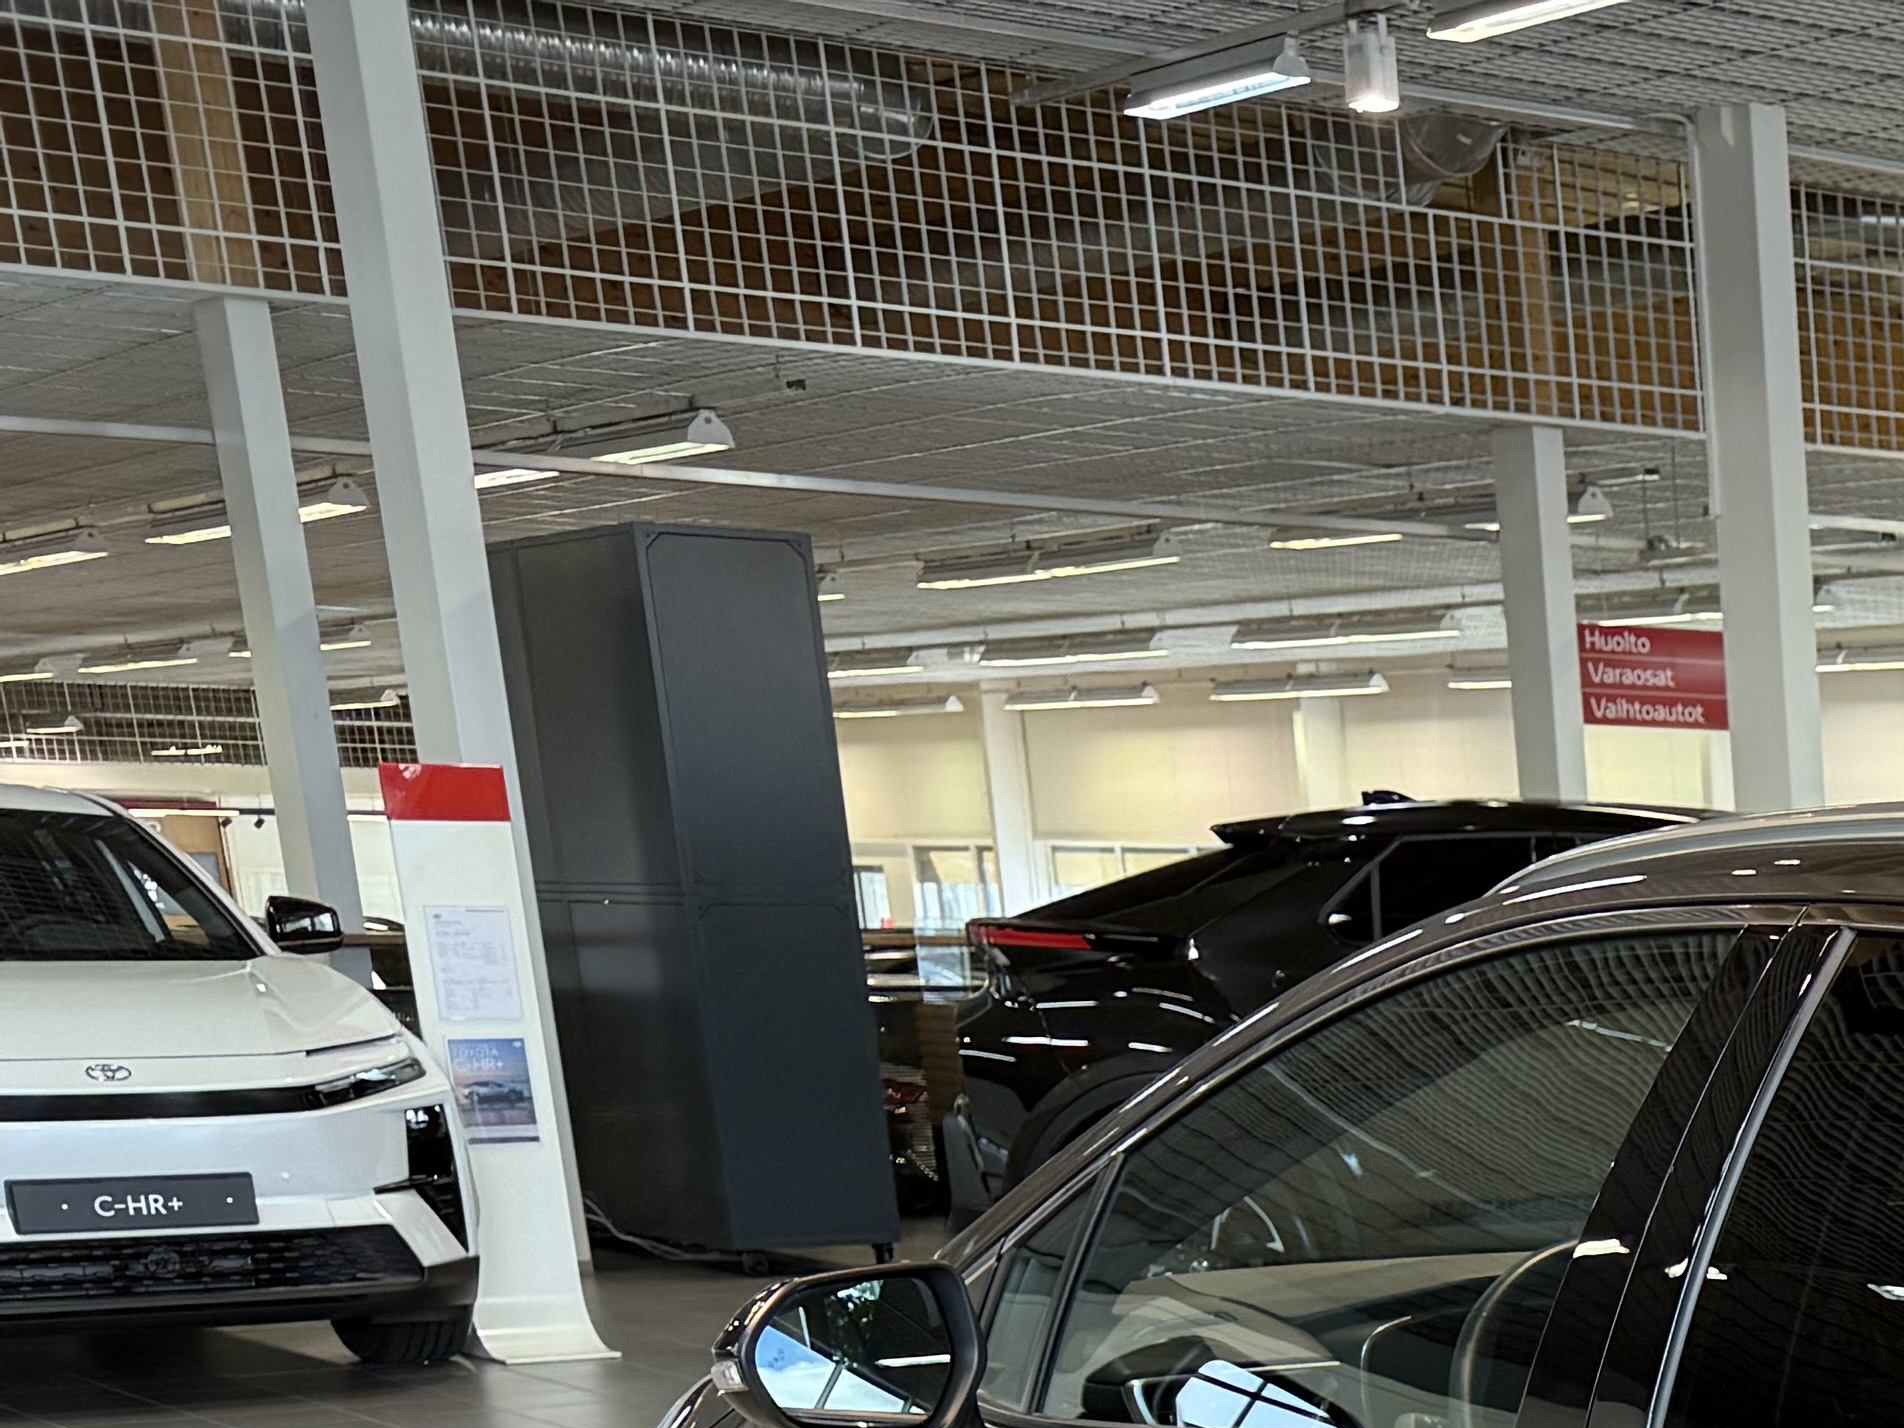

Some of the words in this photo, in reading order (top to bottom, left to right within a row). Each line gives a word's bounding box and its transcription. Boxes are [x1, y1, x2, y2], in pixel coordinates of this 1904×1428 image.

[1585, 629, 1650, 653] Huolto
[1587, 660, 1676, 688] Varaosat
[1591, 697, 1704, 722] Vaihtoautot
[94, 1194, 184, 1217] C-HR+
